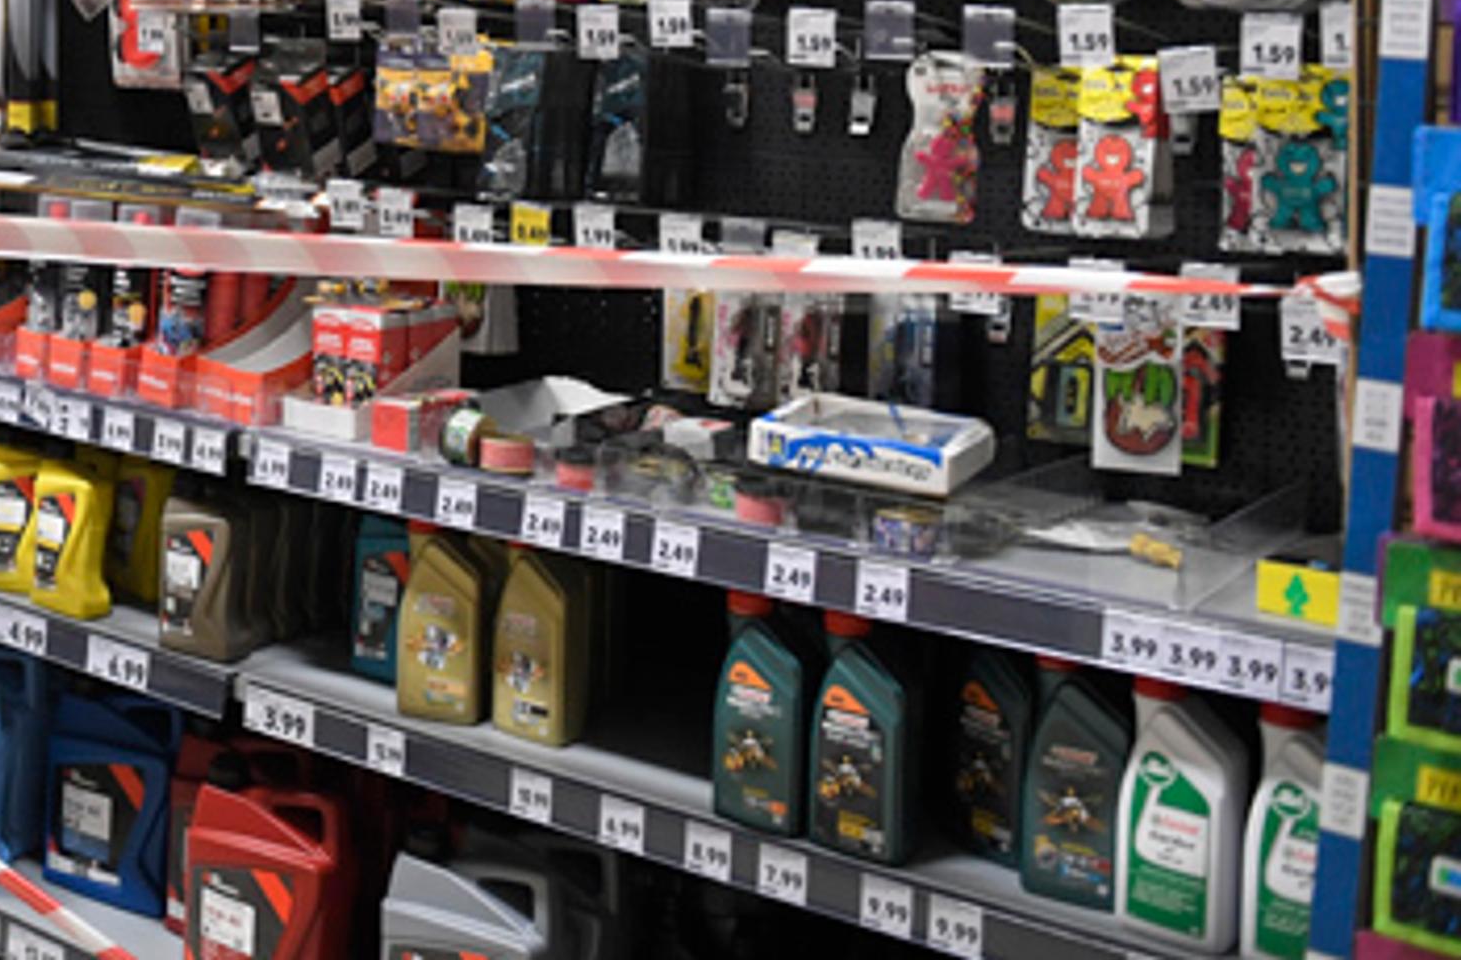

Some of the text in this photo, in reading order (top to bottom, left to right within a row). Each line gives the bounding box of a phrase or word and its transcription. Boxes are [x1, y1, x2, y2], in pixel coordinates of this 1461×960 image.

[1070, 31, 1109, 52] 1.59
[1252, 43, 1296, 66] 1.59
[1172, 74, 1216, 99] 1.59
[1190, 292, 1234, 311] 2.49
[587, 525, 621, 549] 2.49
[659, 538, 696, 564] 2.49
[772, 562, 811, 590] 2.49
[863, 584, 904, 610] 2.49
[1112, 631, 1158, 660] 3.99
[1169, 642, 1217, 672] 3.99
[1226, 655, 1278, 684] 3.99
[1292, 666, 1330, 695] 3.9
[263, 701, 307, 738] 3.99
[868, 898, 909, 926] 9.99
[936, 917, 979, 945] 9.99
